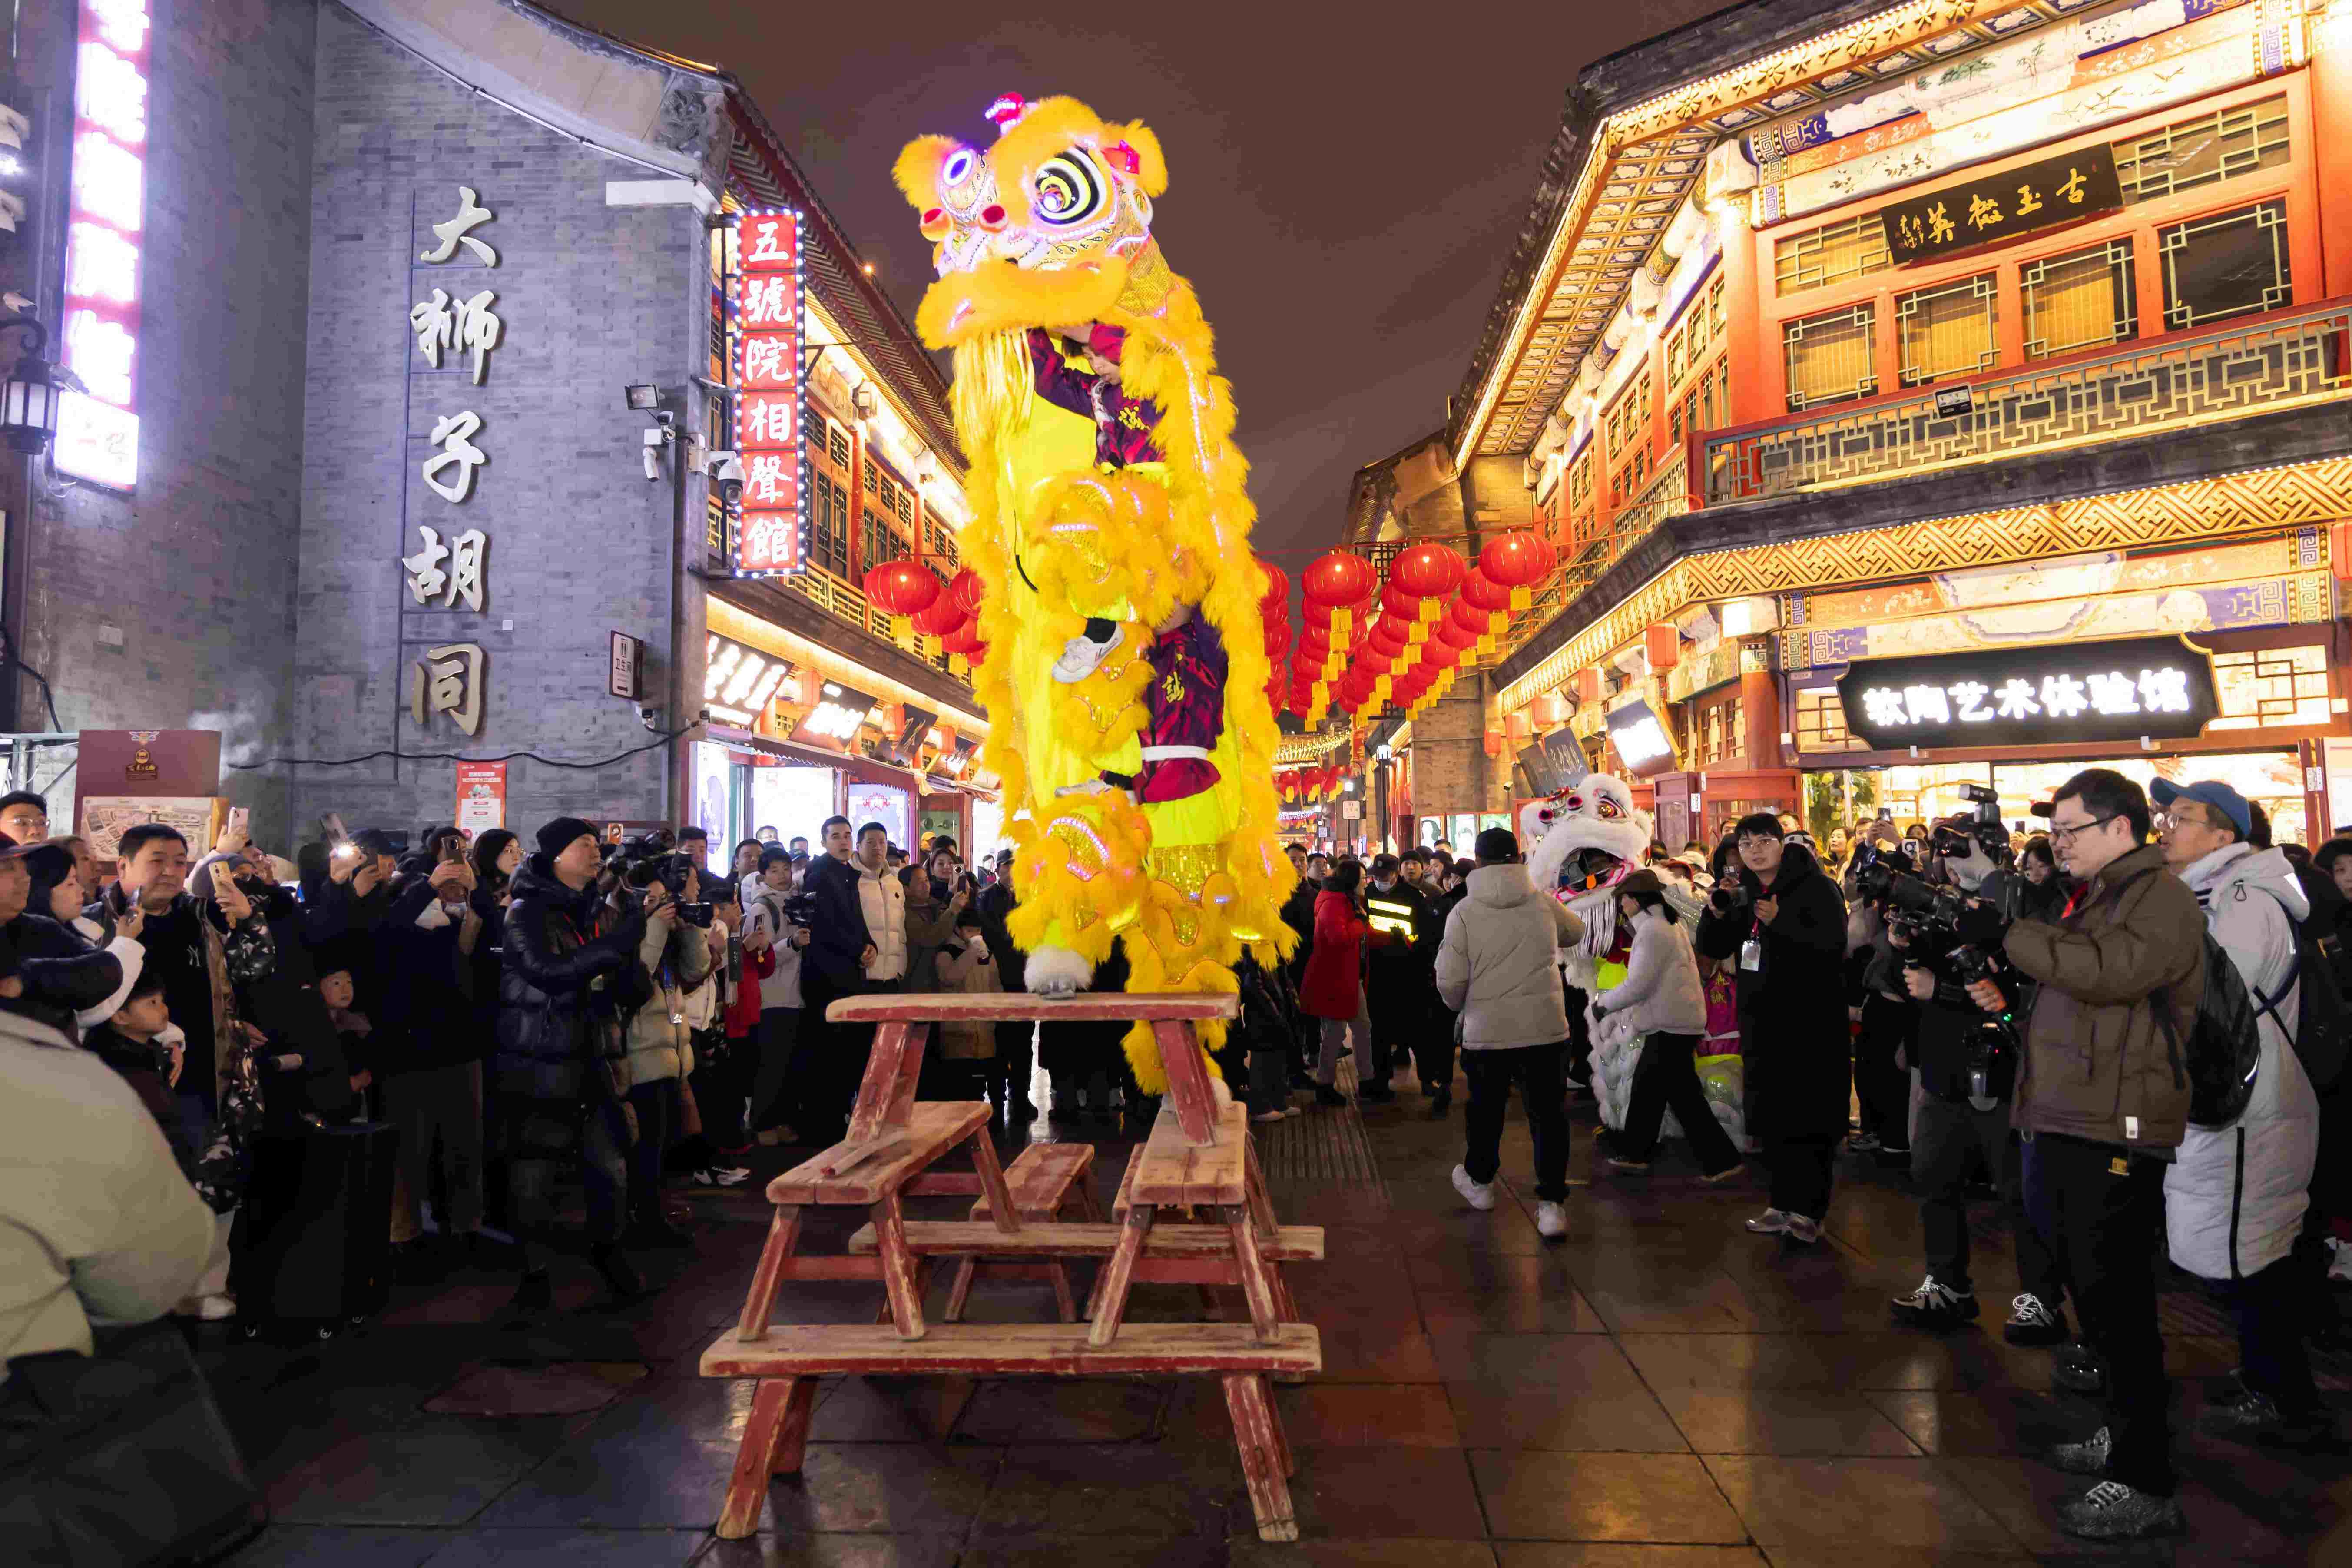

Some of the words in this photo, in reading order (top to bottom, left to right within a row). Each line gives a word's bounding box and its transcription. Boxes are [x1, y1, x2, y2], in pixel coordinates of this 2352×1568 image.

[402, 186, 500, 736] 大狮子胡同
[744, 222, 792, 563] 五號院相聲館
